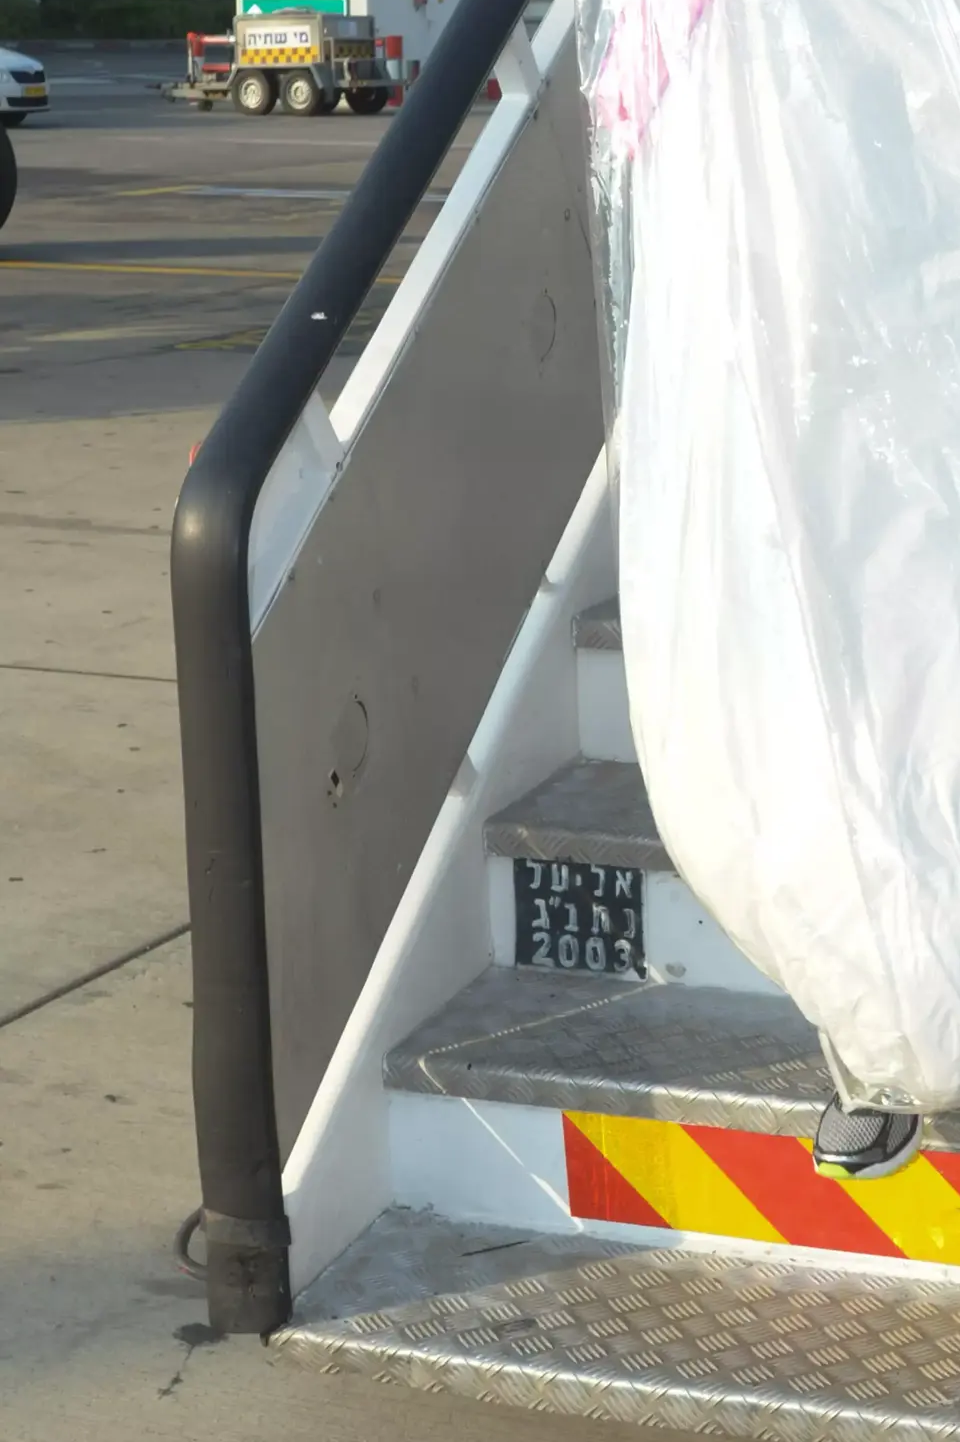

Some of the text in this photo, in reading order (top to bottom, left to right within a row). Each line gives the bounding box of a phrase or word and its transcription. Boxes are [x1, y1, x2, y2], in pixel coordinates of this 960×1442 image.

[247, 31, 310, 46] מי שתיה
[531, 931, 632, 973] 2003
